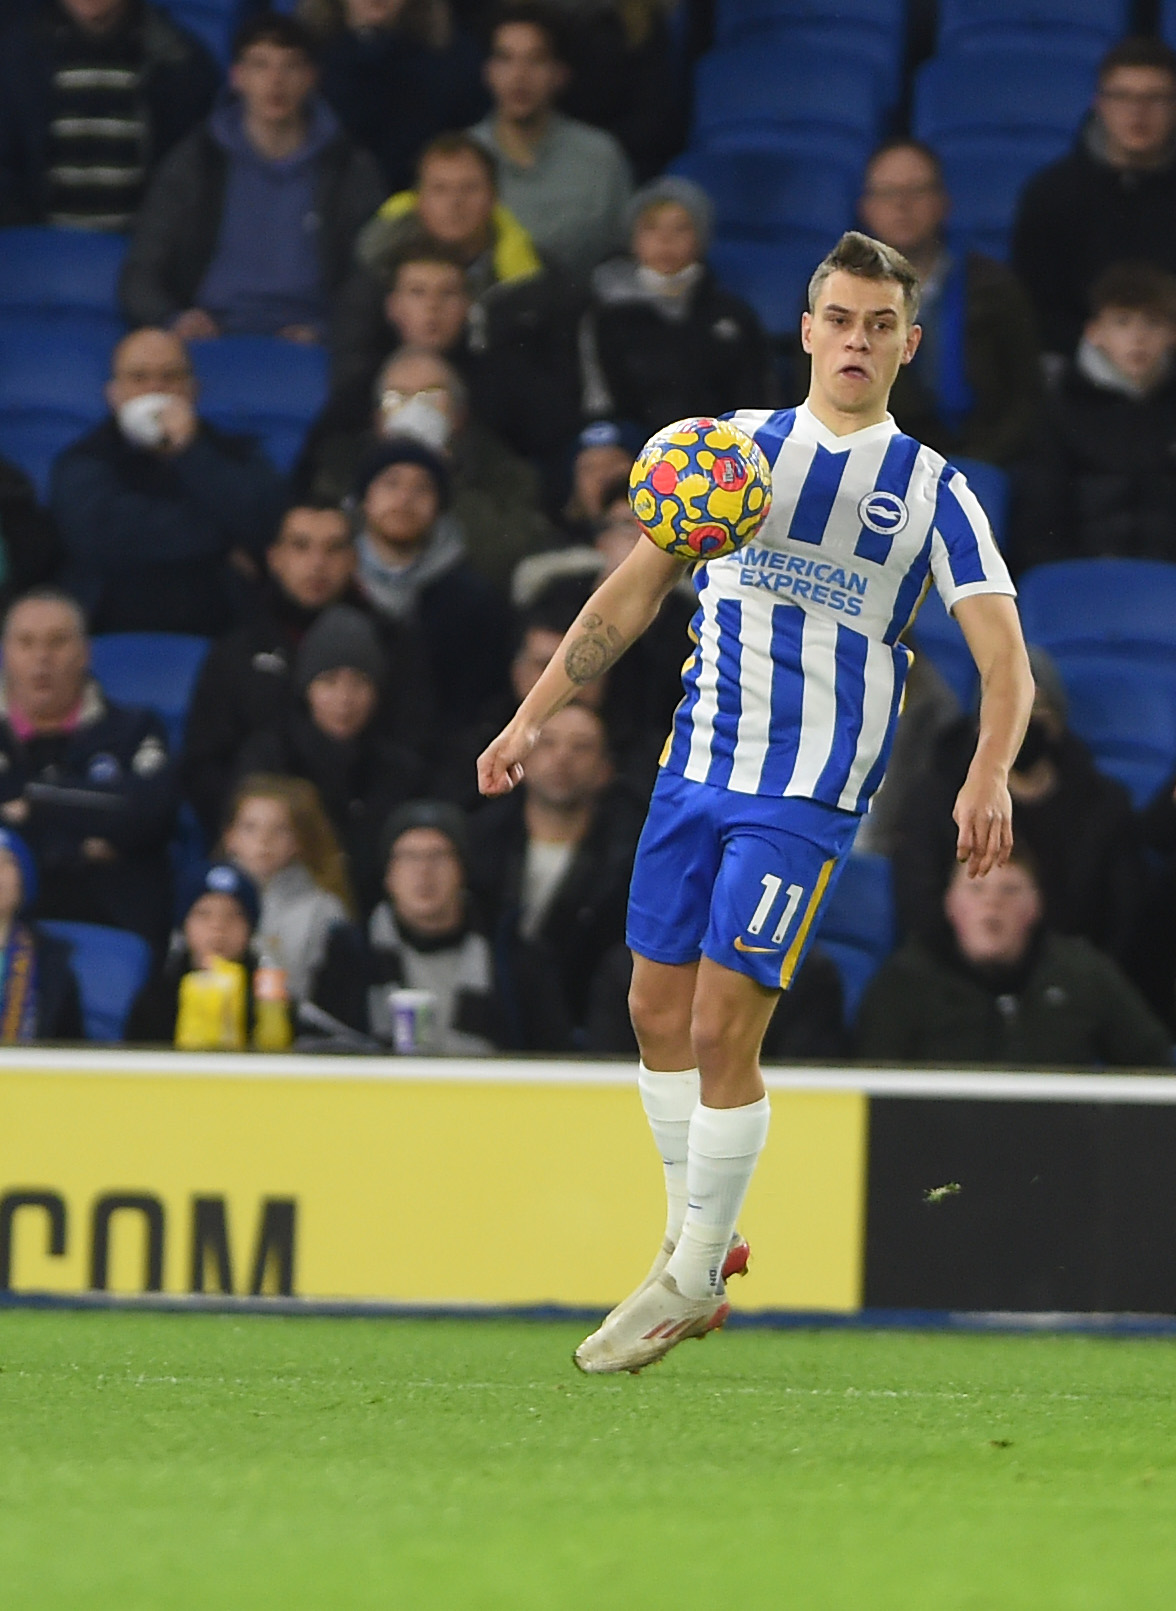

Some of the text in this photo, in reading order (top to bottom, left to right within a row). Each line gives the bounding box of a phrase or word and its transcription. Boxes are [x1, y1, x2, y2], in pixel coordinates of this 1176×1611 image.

[727, 547, 868, 595] AMERICAN
[740, 567, 863, 616] EXPRESS
[746, 873, 804, 944] 11
